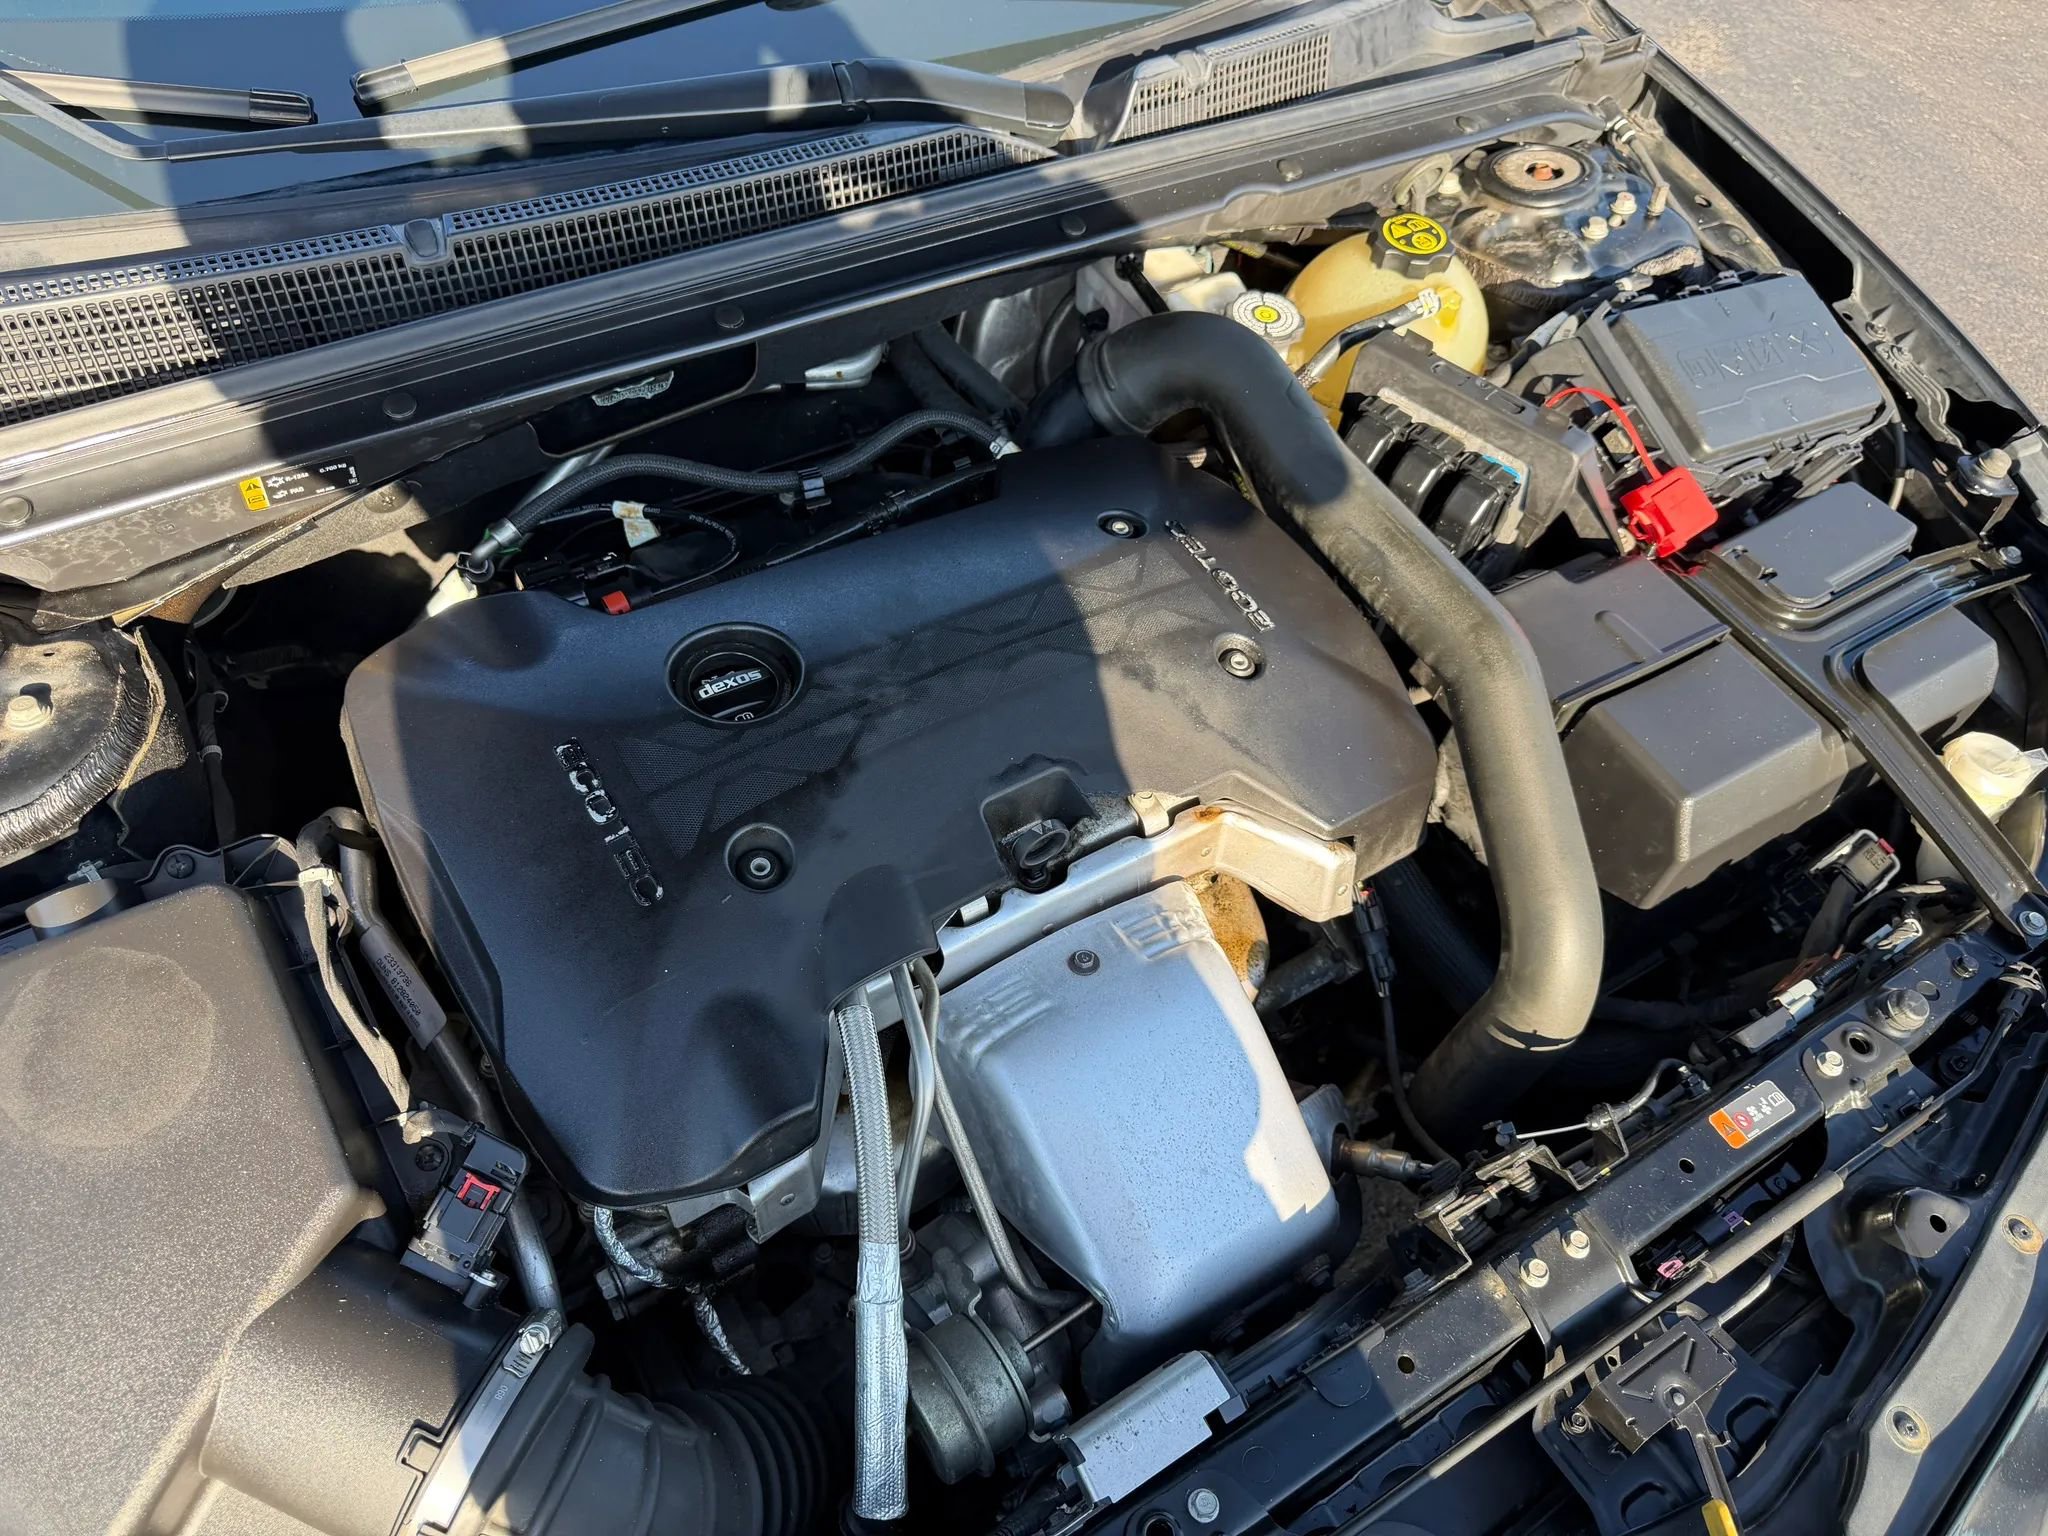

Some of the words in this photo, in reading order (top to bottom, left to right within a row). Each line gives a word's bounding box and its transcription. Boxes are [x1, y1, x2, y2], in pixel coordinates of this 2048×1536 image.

[1164, 520, 1276, 633] ECOTEC
[698, 669, 762, 699] dexos
[553, 737, 664, 907] ECOTEC
